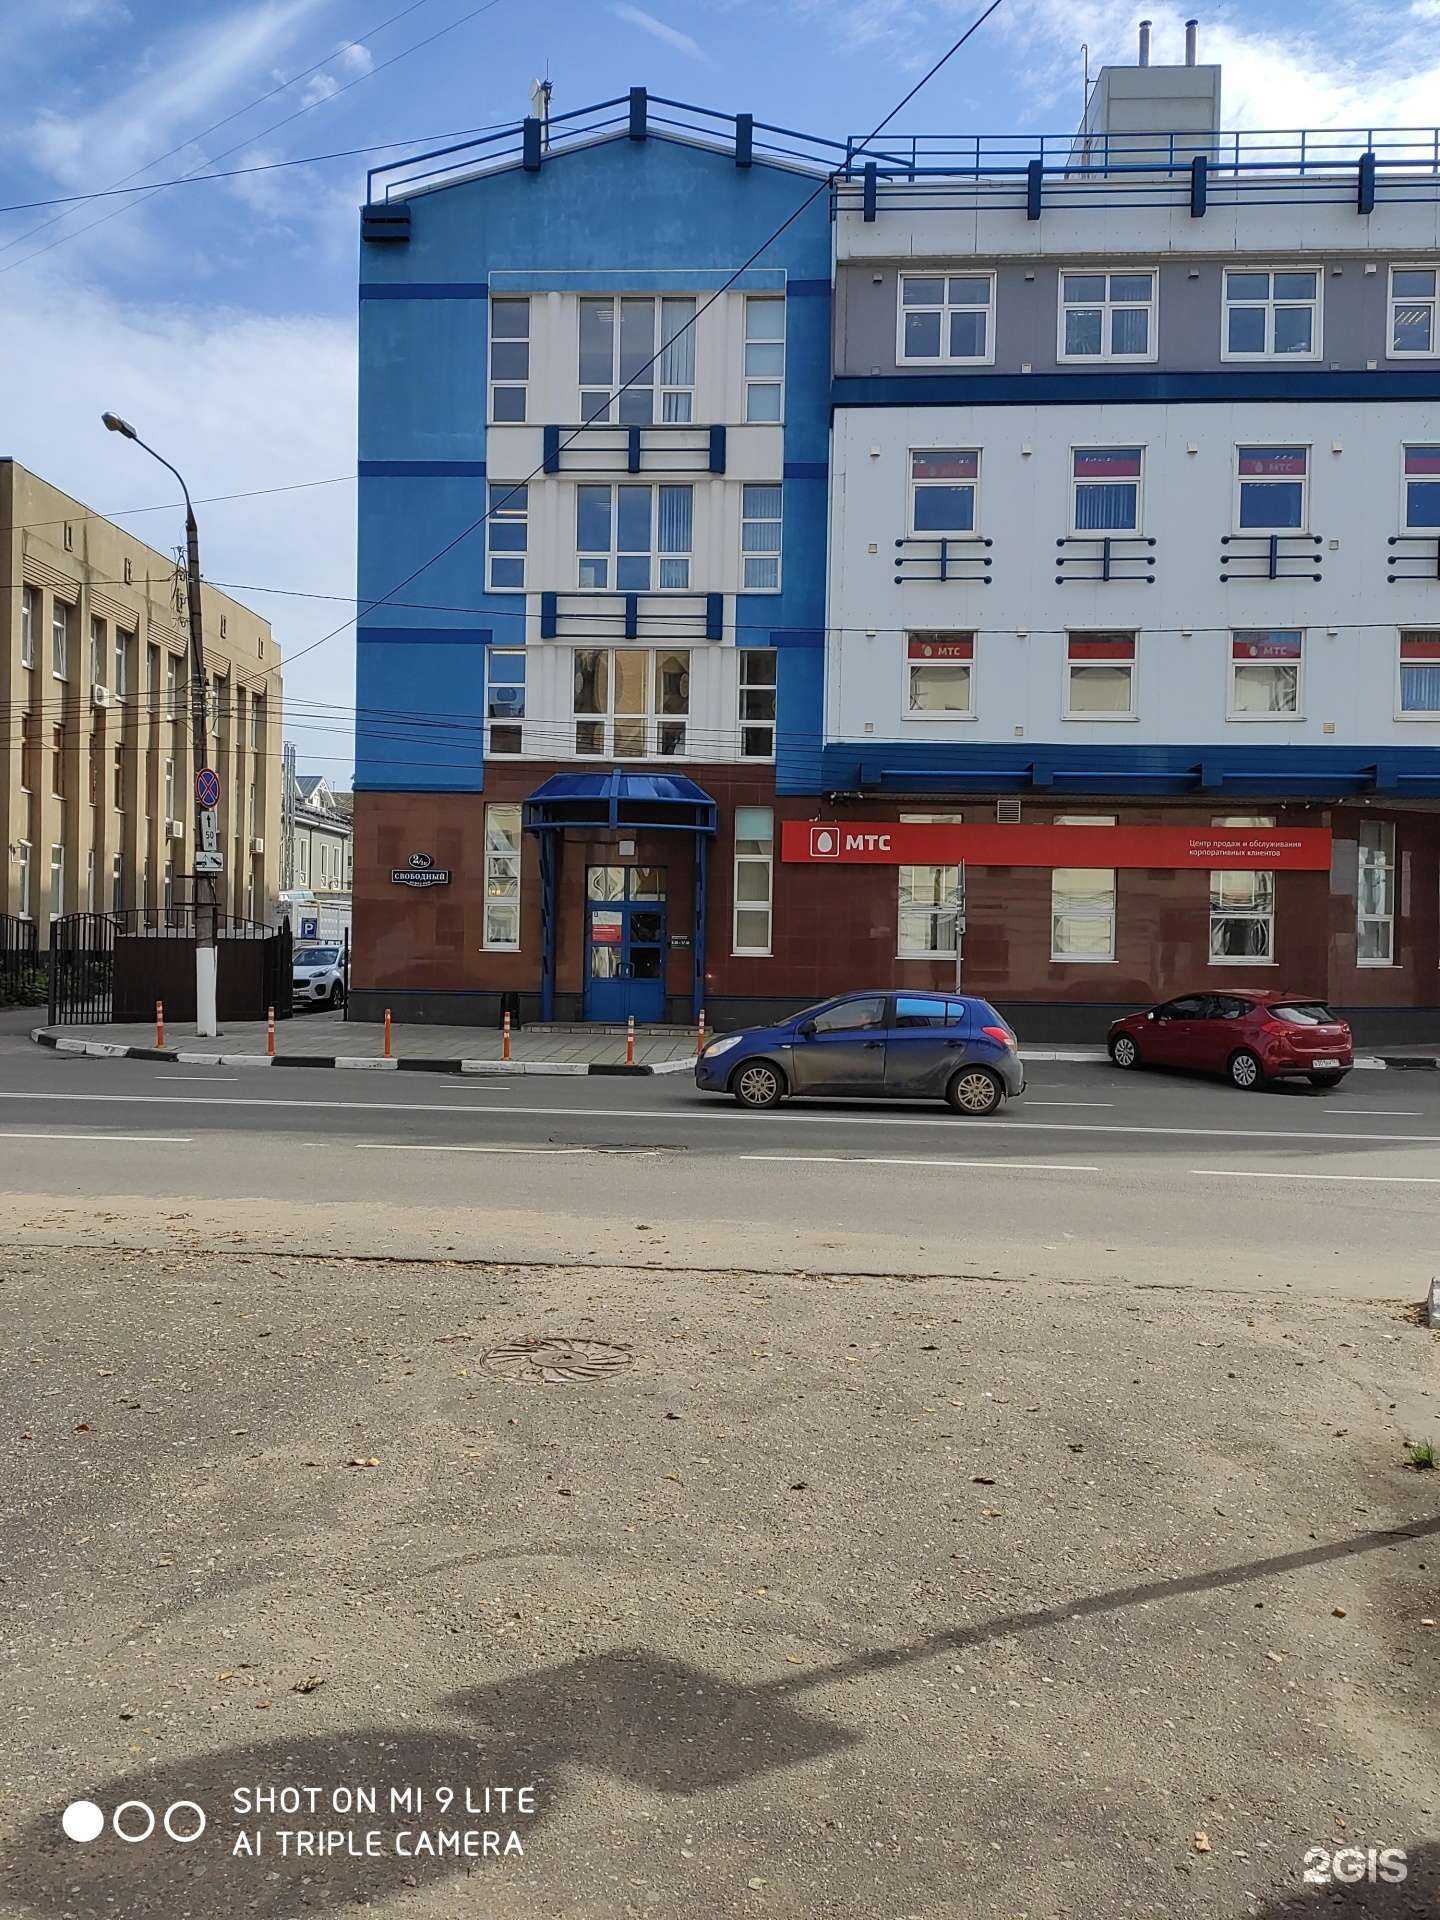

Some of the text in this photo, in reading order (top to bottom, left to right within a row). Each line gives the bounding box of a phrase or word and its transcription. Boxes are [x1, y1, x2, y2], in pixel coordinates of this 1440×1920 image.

[938, 647, 961, 656] МТС
[1263, 646, 1287, 656] МТС
[205, 831, 214, 840] 50
[846, 835, 891, 851] МТС
[1189, 839, 1212, 849] Центр
[1213, 841, 1241, 849] продаж
[1249, 840, 1302, 849] обслуживания
[1189, 849, 1246, 857] корпоративных
[394, 872, 445, 881] СВОБОДНЫЙ
[304, 923, 314, 935] P
